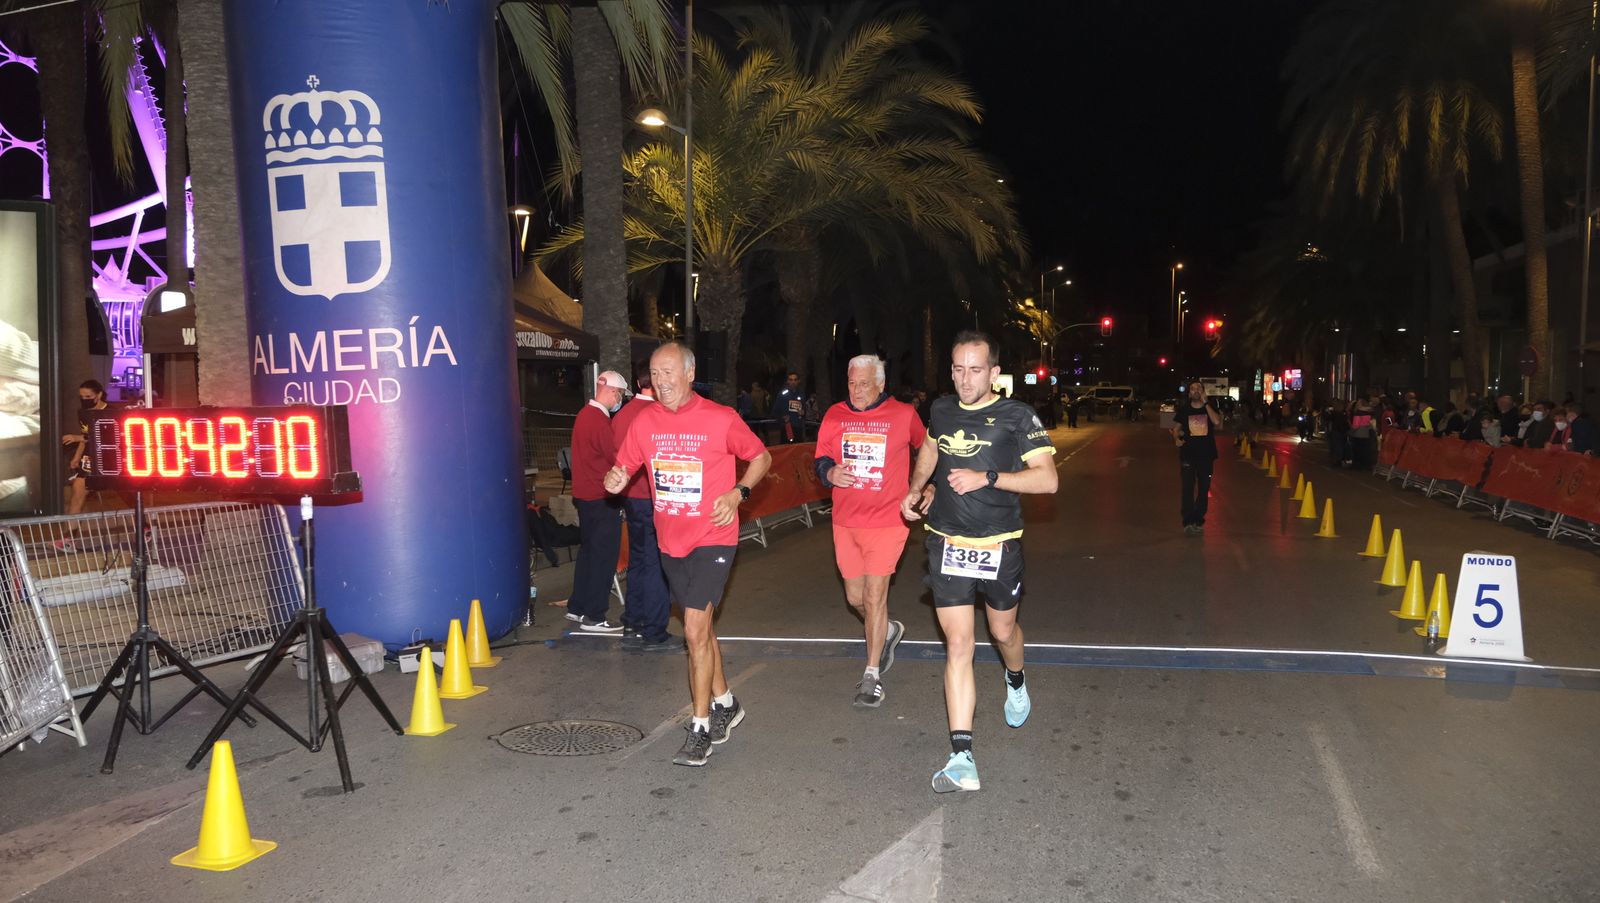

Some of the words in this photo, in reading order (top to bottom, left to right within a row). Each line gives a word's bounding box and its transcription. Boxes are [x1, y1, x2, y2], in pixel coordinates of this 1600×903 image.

[253, 316, 458, 375] ALMERÍA
[284, 378, 401, 407] CIUDAD
[955, 549, 991, 564] 382
[1467, 557, 1512, 567] MONDO
[1472, 583, 1504, 629] 5
